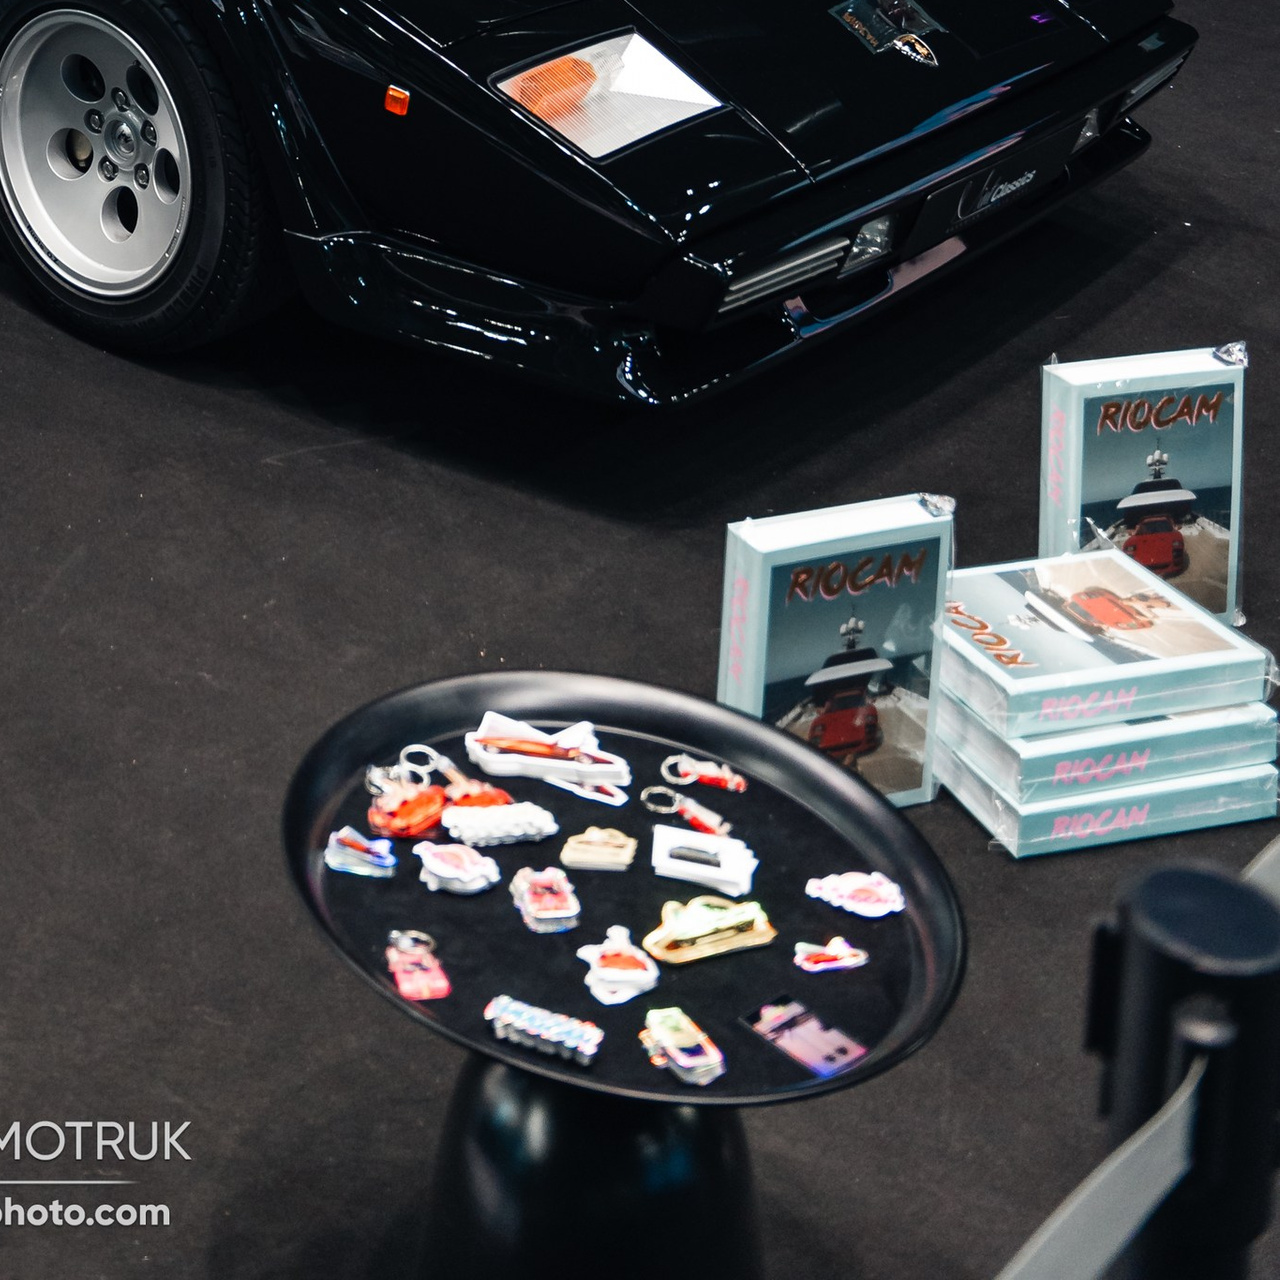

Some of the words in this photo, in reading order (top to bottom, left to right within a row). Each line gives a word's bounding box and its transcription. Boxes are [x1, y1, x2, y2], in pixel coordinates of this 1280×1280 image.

[1097, 392, 1223, 436] RIOCAM
[785, 548, 927, 607] RIOCAM
[1039, 686, 1138, 721] RIOCAM
[1052, 748, 1151, 785] RIOCAM
[1051, 803, 1150, 841] RIOCAM
